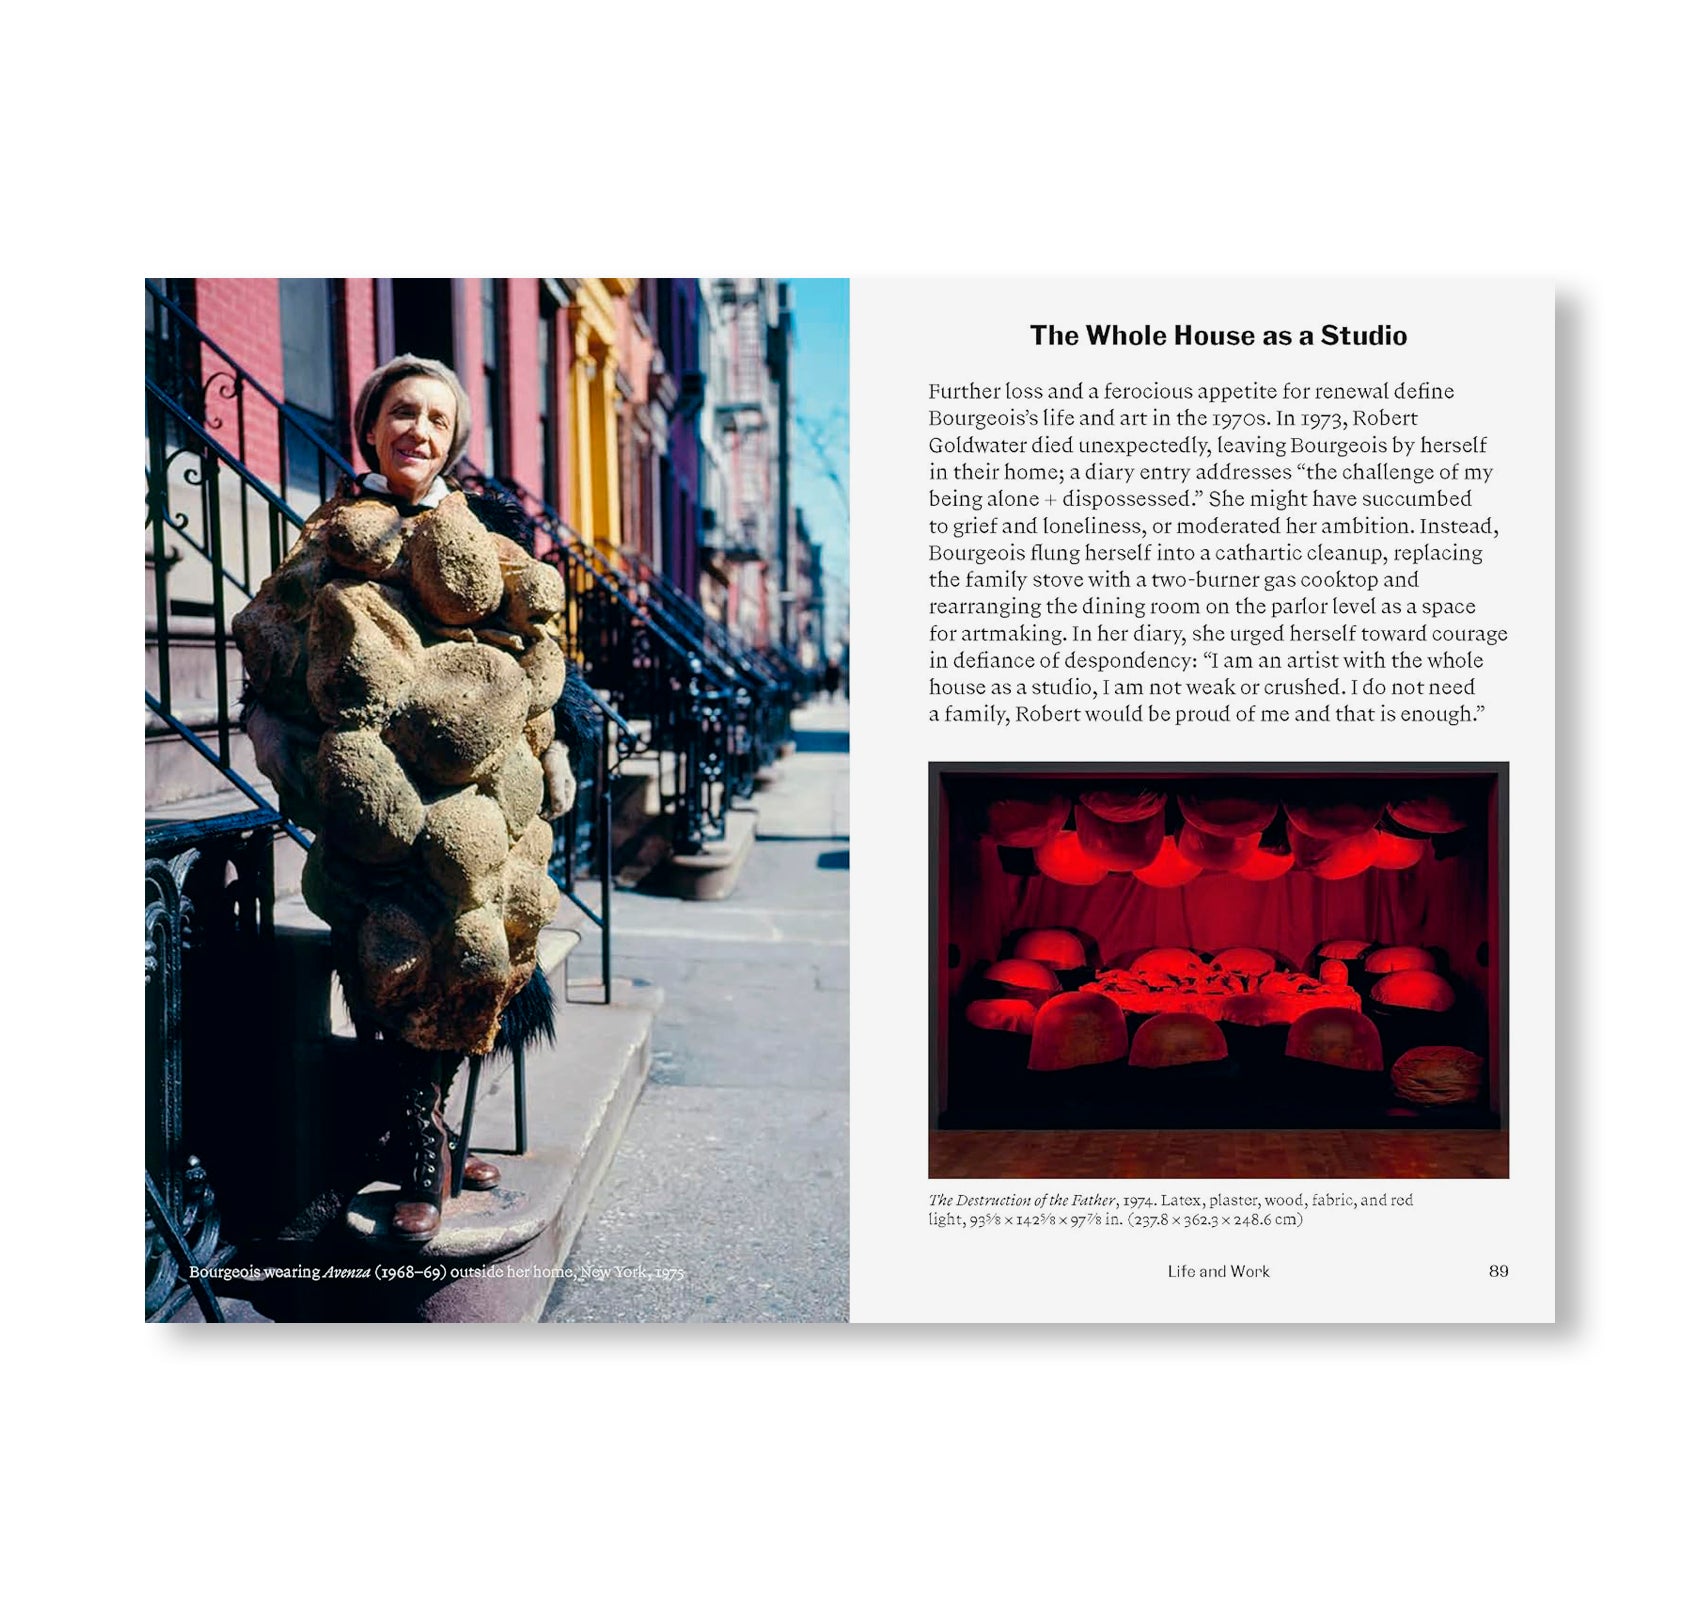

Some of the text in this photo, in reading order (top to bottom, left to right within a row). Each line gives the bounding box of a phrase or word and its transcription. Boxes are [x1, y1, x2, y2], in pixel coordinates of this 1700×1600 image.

[1030, 324, 1407, 346] The Whole House as a Studio
[929, 381, 1454, 403] Further loss and a ferocious appetite for renewal define
[929, 408, 1418, 430] Bourgeois’s life and art in the 1970s. In 1973, Robert
[929, 436, 1487, 458] Goldwater died unexpectedly, leaving Bourgeois by herself
[930, 462, 1493, 484] in their home; a diary entry addresses “the challenge of my
[929, 516, 1498, 539] to grief and loneliness, or moderated her ambition. Instead,
[929, 543, 1483, 565] Bourgeois flung herself into cathartic cleanup, replacing
[929, 570, 1419, 591] the family stove with a two-burner gas cooktop and
[930, 624, 1507, 646] for artmaking. In her diary, she urged herself toward courage
[930, 650, 1483, 672] in defiance of despondency: “I am an artist with the whole
[929, 678, 1475, 700] house as a studio, I am not weak or crushed. I do not need
[929, 704, 1485, 727] a family, Robert would be proud of me and that is enough.”
[930, 1193, 1413, 1209] The Destruction of the Father, 1974. Latex, plaster, wood, fabric, and red
[929, 1212, 966, 1228] light,
[1106, 1212, 1123, 1225] in.
[1128, 1212, 1168, 1228] (237.8
[1184, 1214, 1218, 1228] 362.3
[1234, 1213, 1271, 1227] 248.6
[1275, 1212, 1303, 1227] cm)
[189, 1264, 261, 1281] Bourgeois
[263, 1264, 321, 1281] wearing
[322, 1265, 371, 1279] Avenza
[450, 1264, 504, 1278] outside
[507, 1264, 531, 1278] her
[534, 1264, 578, 1281] home,
[580, 1265, 611, 1279] New
[616, 1265, 651, 1281] York,
[655, 1267, 685, 1281] 1975
[1169, 1265, 1270, 1277] Life and Work
[1489, 1265, 1508, 1277] 89
